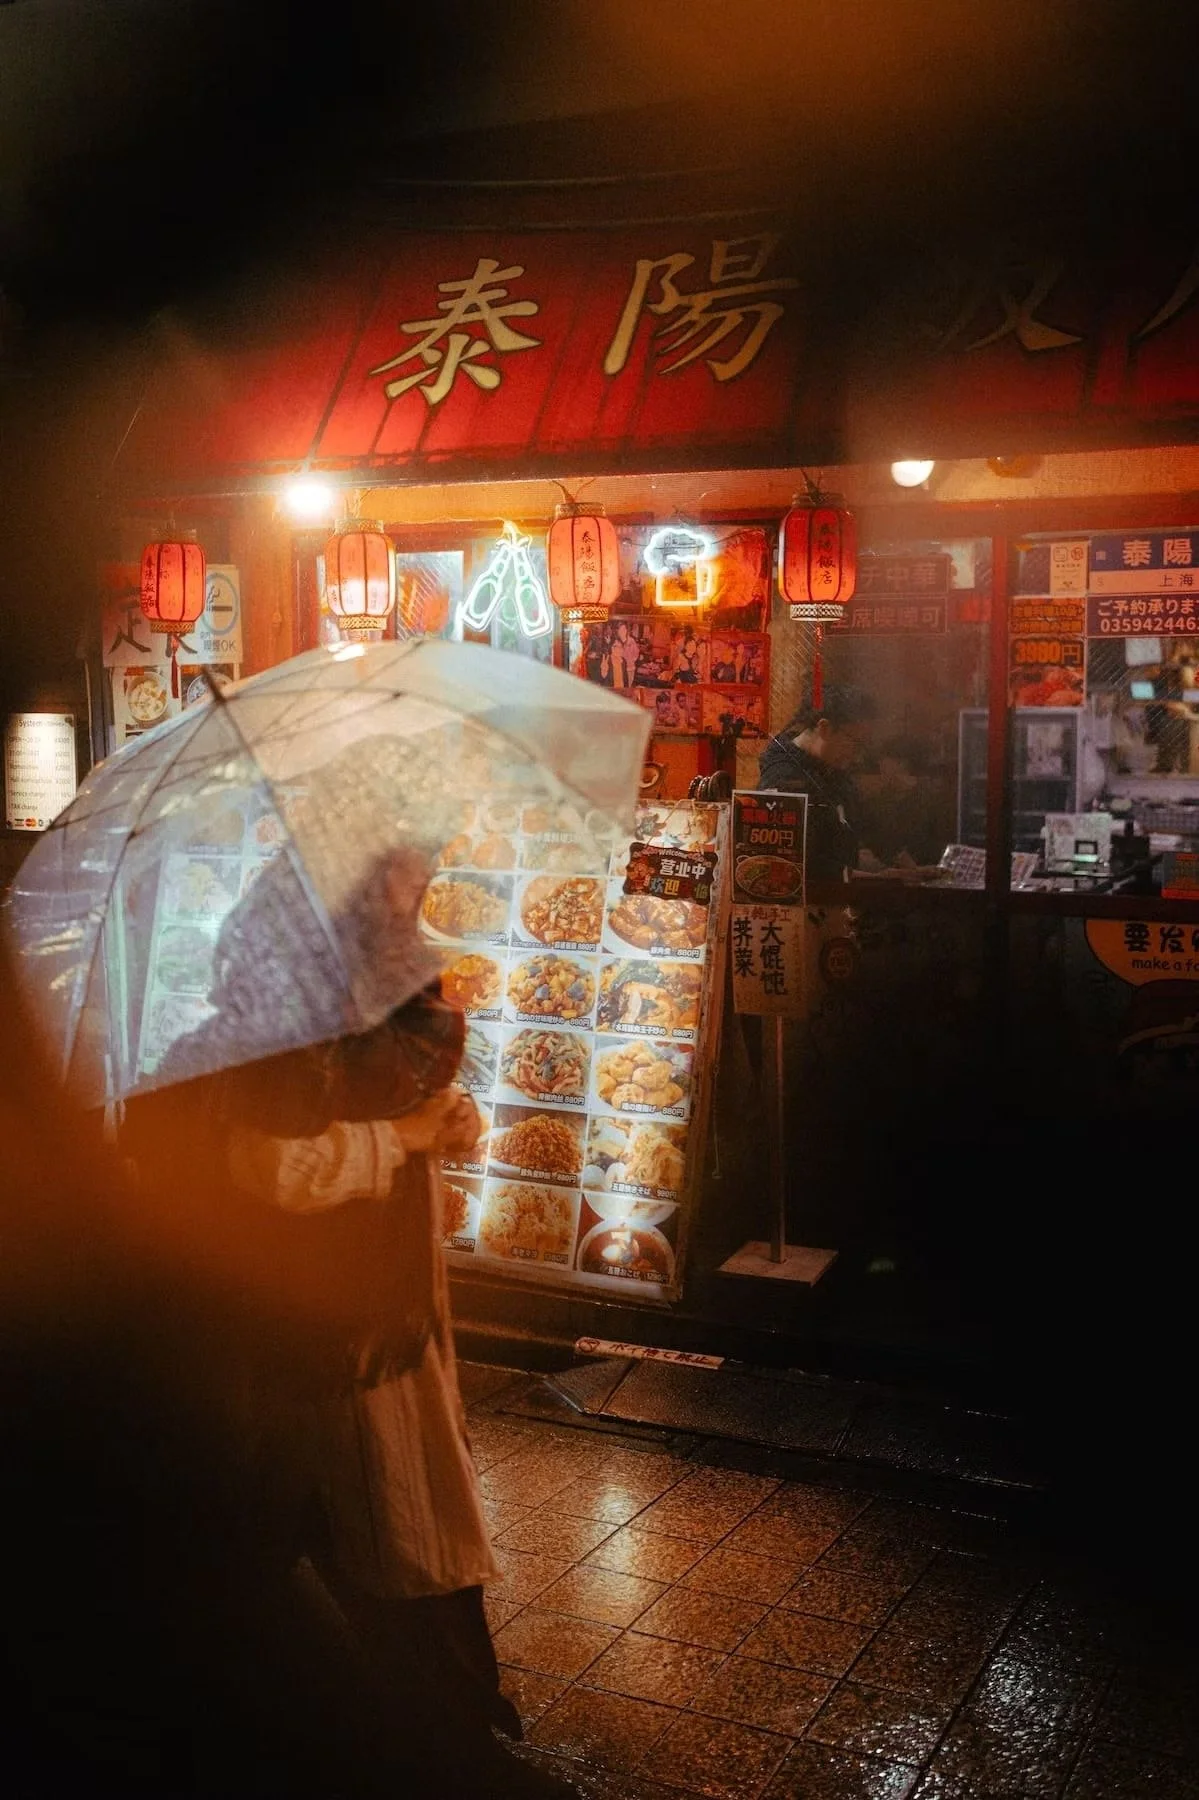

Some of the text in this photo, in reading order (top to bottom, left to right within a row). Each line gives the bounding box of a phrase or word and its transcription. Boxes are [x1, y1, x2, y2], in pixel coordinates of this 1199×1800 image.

[1122, 538, 1193, 568] 泰陽
[1158, 573, 1195, 588] 上海
[1100, 616, 1199, 633] 035942446
[750, 828, 793, 847] 500円
[1131, 957, 1170, 970] make
